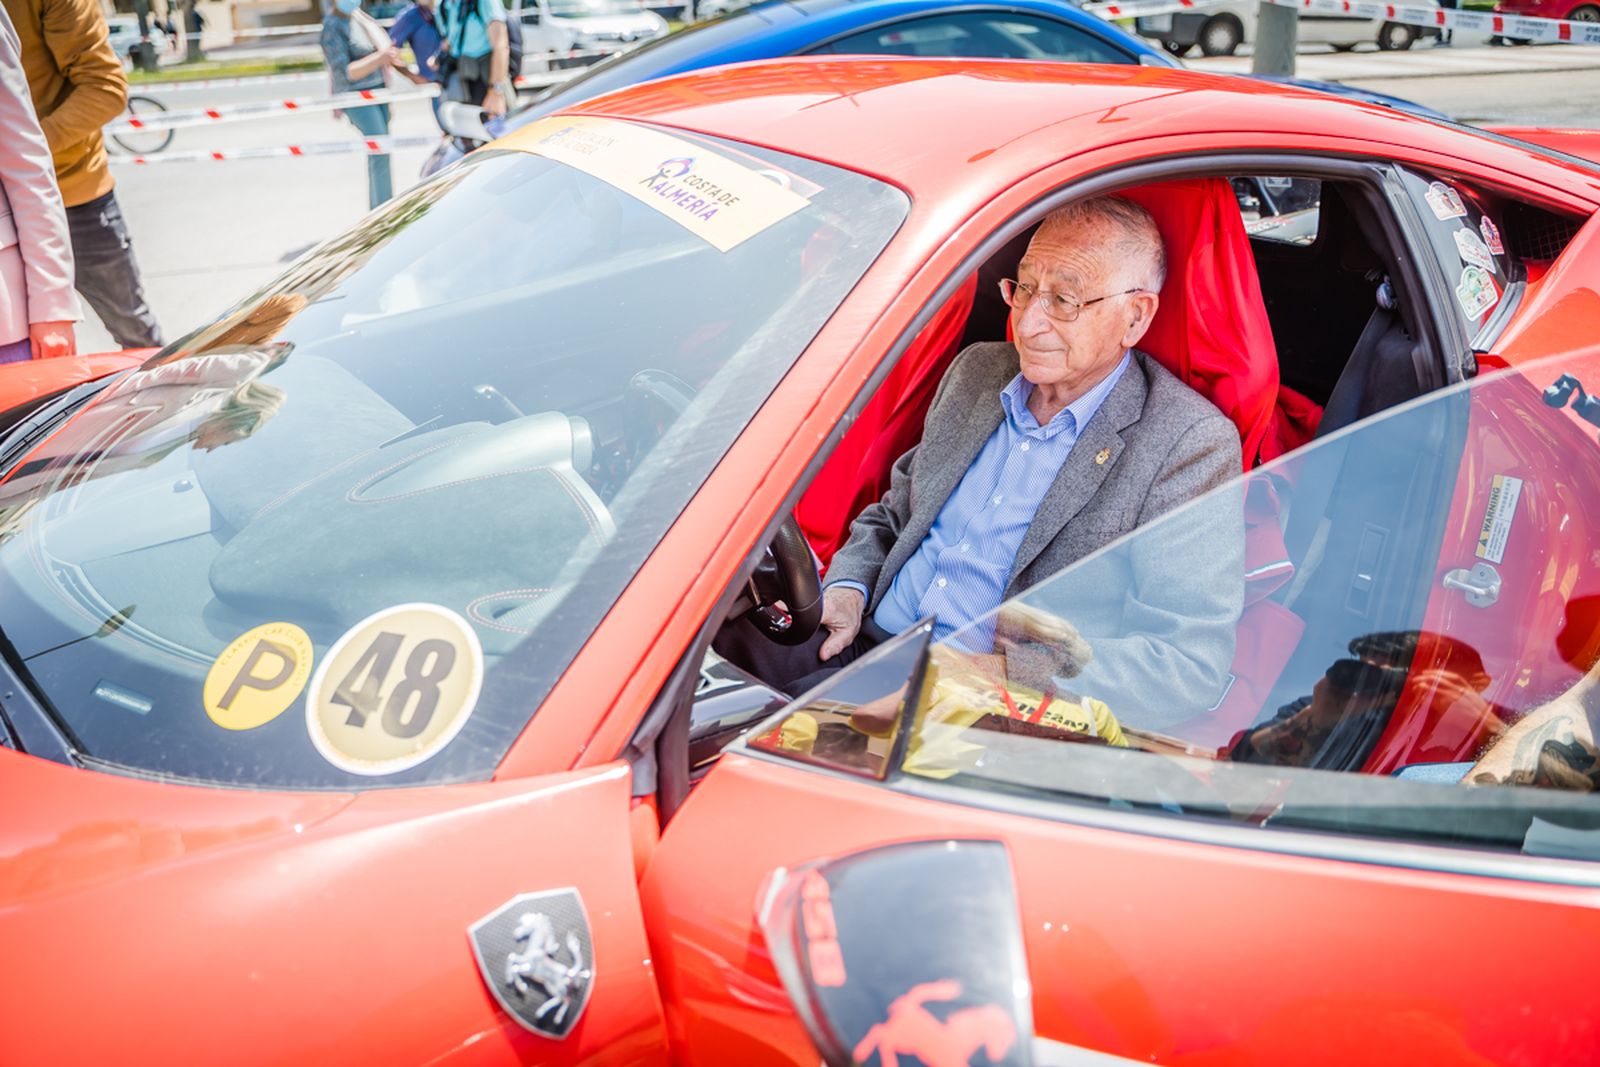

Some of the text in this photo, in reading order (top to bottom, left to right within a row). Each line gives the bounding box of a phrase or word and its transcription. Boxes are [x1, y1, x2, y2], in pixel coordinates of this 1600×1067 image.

[652, 180, 719, 222] ALMERÍA
[682, 174, 740, 207] COSTA DE
[1482, 487, 1500, 532] WARNING
[264, 628, 283, 636] CAR
[216, 638, 297, 711] P
[330, 631, 457, 739] 48
